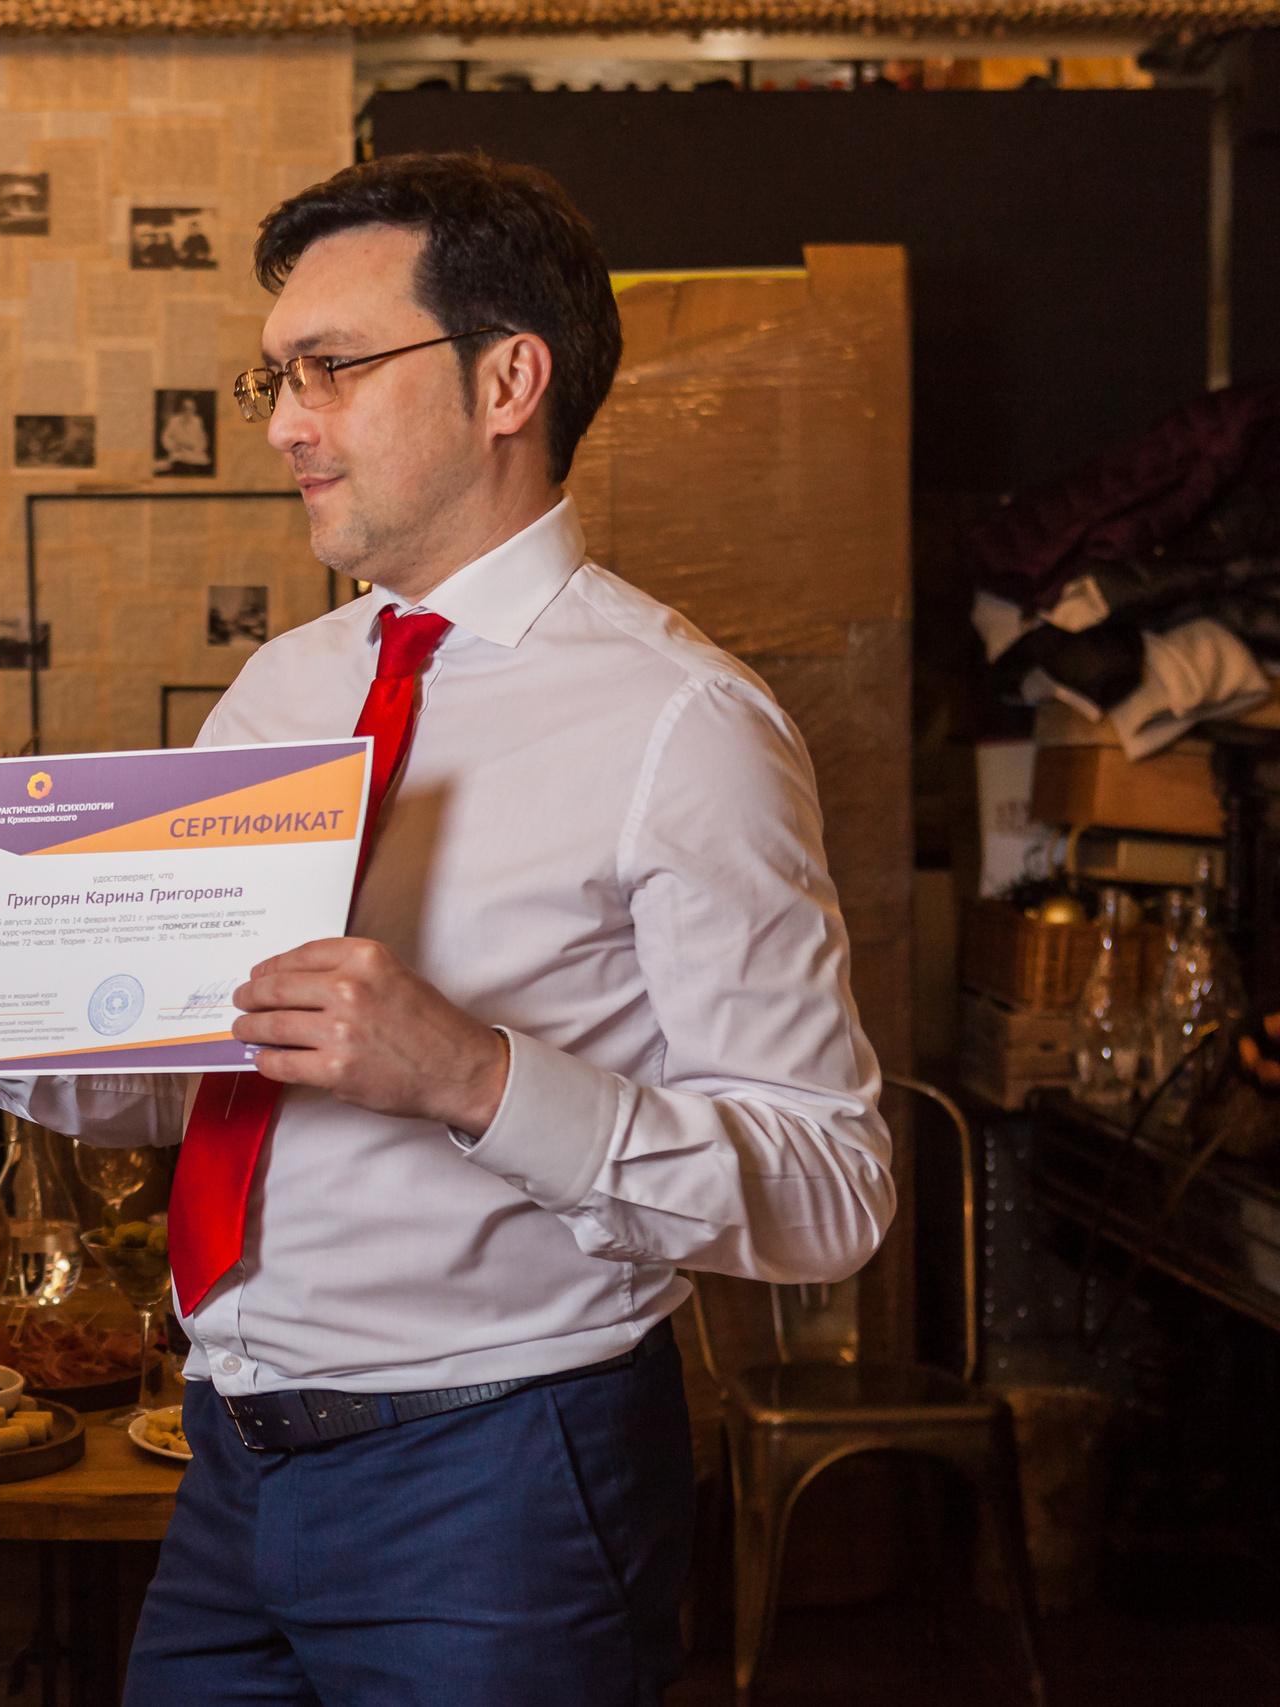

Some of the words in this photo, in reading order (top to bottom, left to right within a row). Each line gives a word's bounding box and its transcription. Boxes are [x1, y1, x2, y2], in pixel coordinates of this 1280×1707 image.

[56, 802, 115, 812] ПСИХОЛОГИИ
[7, 814, 78, 825] Кржижановского
[170, 809, 344, 839] СЕРТИФИКАТ
[92, 873, 155, 884] удостоверяет,
[159, 872, 174, 880] что
[7, 893, 80, 909] Григорян
[85, 891, 144, 907] Карина
[150, 886, 243, 904] Григоровна
[3, 918, 32, 928] августа
[33, 917, 53, 926] 2020
[60, 917, 70, 925] по
[73, 916, 81, 924] 14
[83, 916, 116, 925] февраля
[118, 914, 136, 923] 2021
[146, 913, 179, 923] успешно
[58, 926, 110, 937] практической
[111, 924, 155, 934] психологии
[157, 921, 198, 931] «ПОМОГИ
[200, 920, 221, 929] СЕБЕ
[223, 919, 246, 928] САМ»
[22, 938, 31, 947] 72
[60, 937, 86, 946] Теория
[93, 936, 103, 945] 22
[114, 935, 150, 944] Практика
[157, 933, 168, 942] 30
[240, 929, 251, 938] 20
